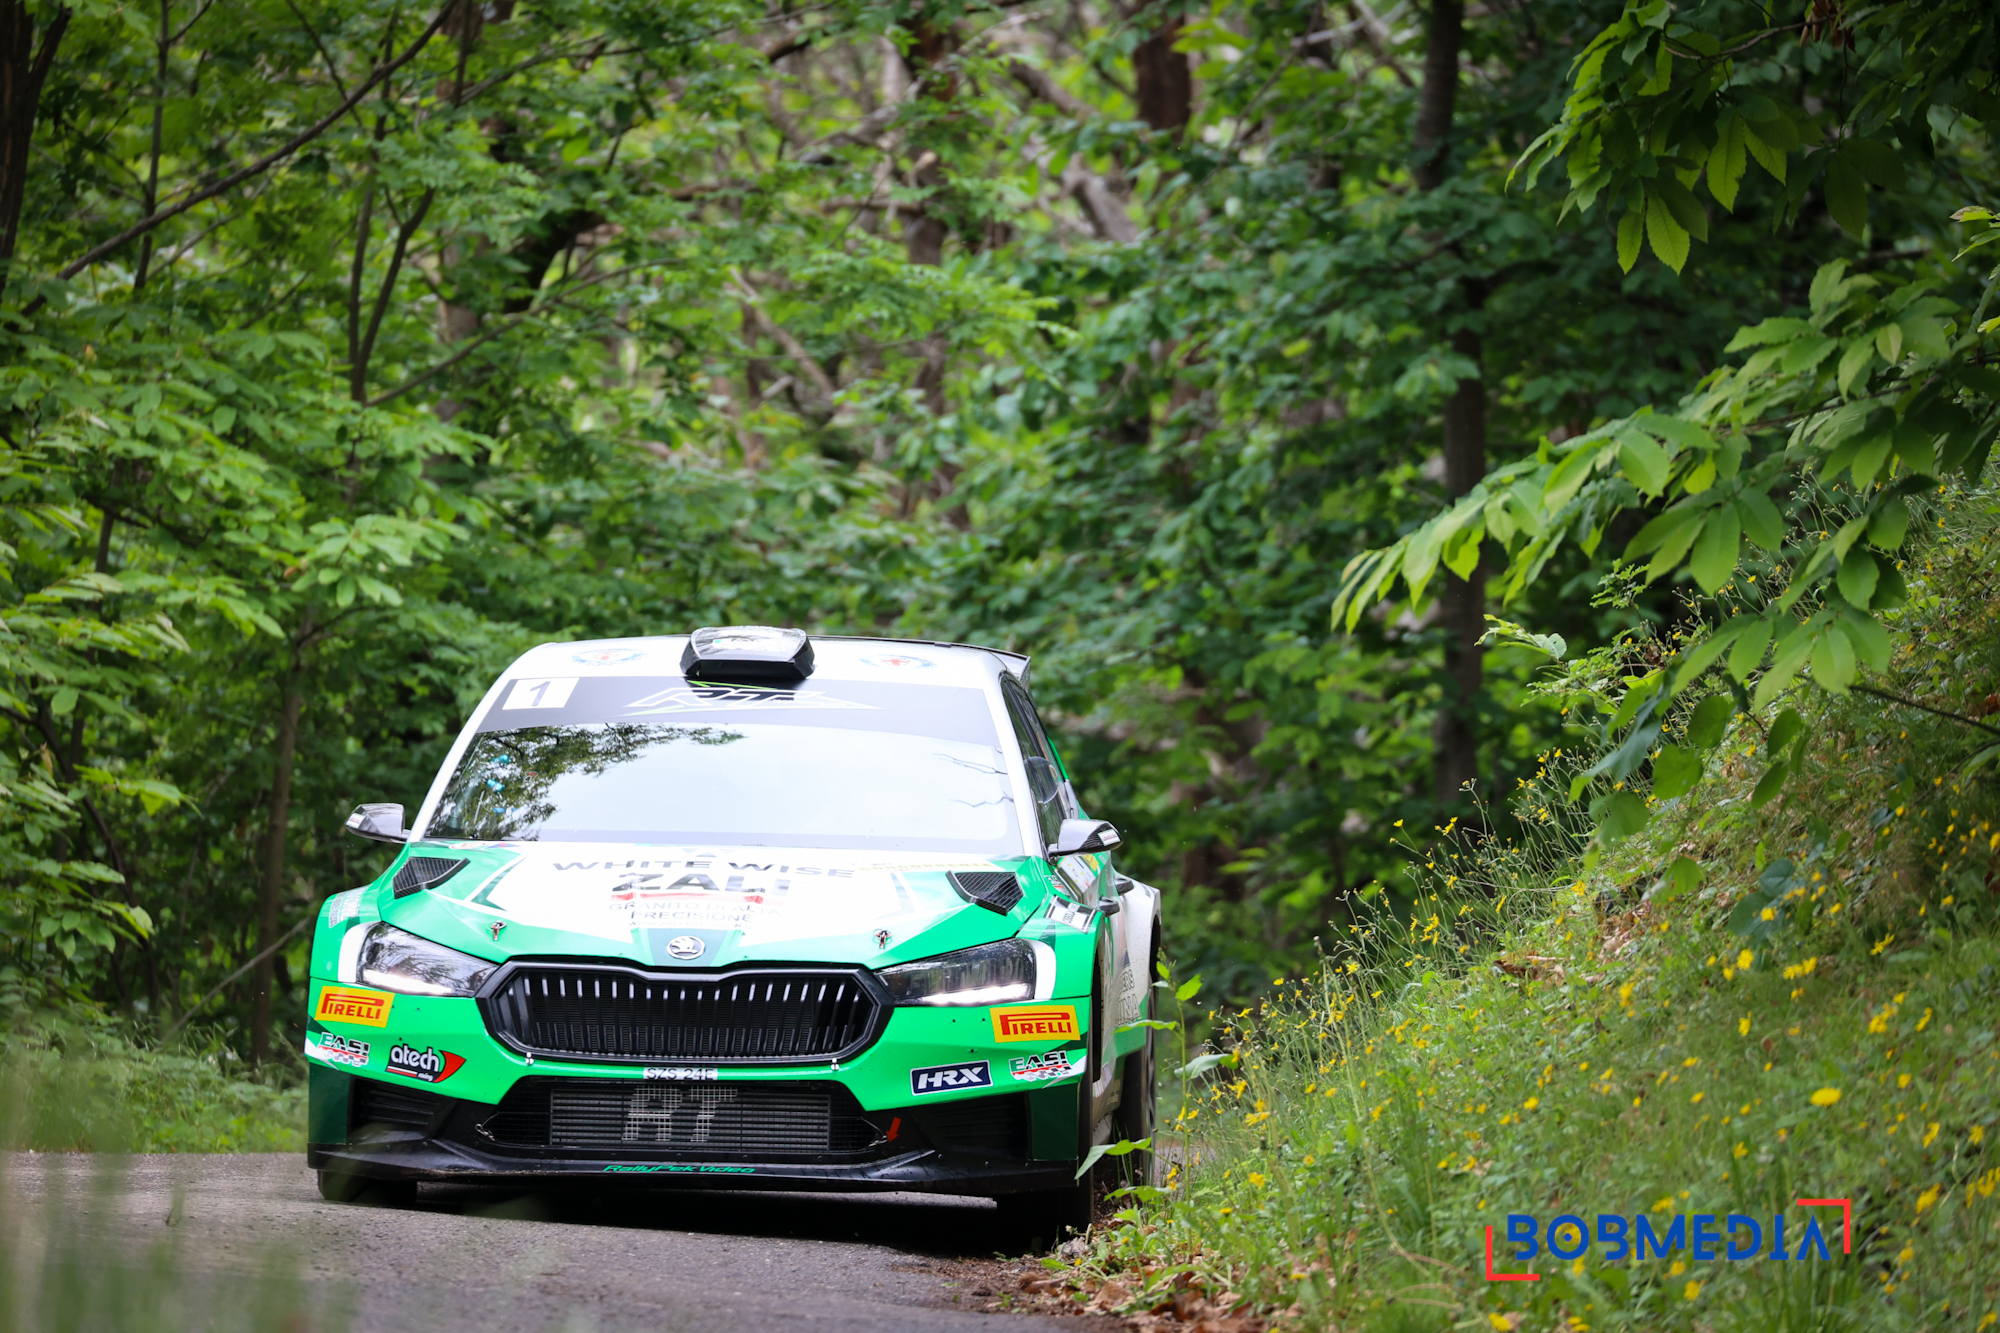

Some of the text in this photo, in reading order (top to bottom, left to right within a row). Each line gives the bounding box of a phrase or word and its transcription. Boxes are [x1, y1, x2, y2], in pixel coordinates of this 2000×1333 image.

[529, 681, 551, 707] 1
[552, 860, 713, 871] WHITE
[728, 862, 855, 878] WISE
[612, 872, 791, 896] ZALI
[609, 901, 781, 916] GRANITO DI ALTA
[630, 910, 754, 923] PRECISIONE
[321, 993, 385, 1020] PIRELLI
[999, 1012, 1072, 1036] PIRELLI
[390, 1044, 440, 1072] atech
[646, 1067, 677, 1080] SZS
[917, 1066, 984, 1090] HRX
[622, 1085, 738, 1142] RT
